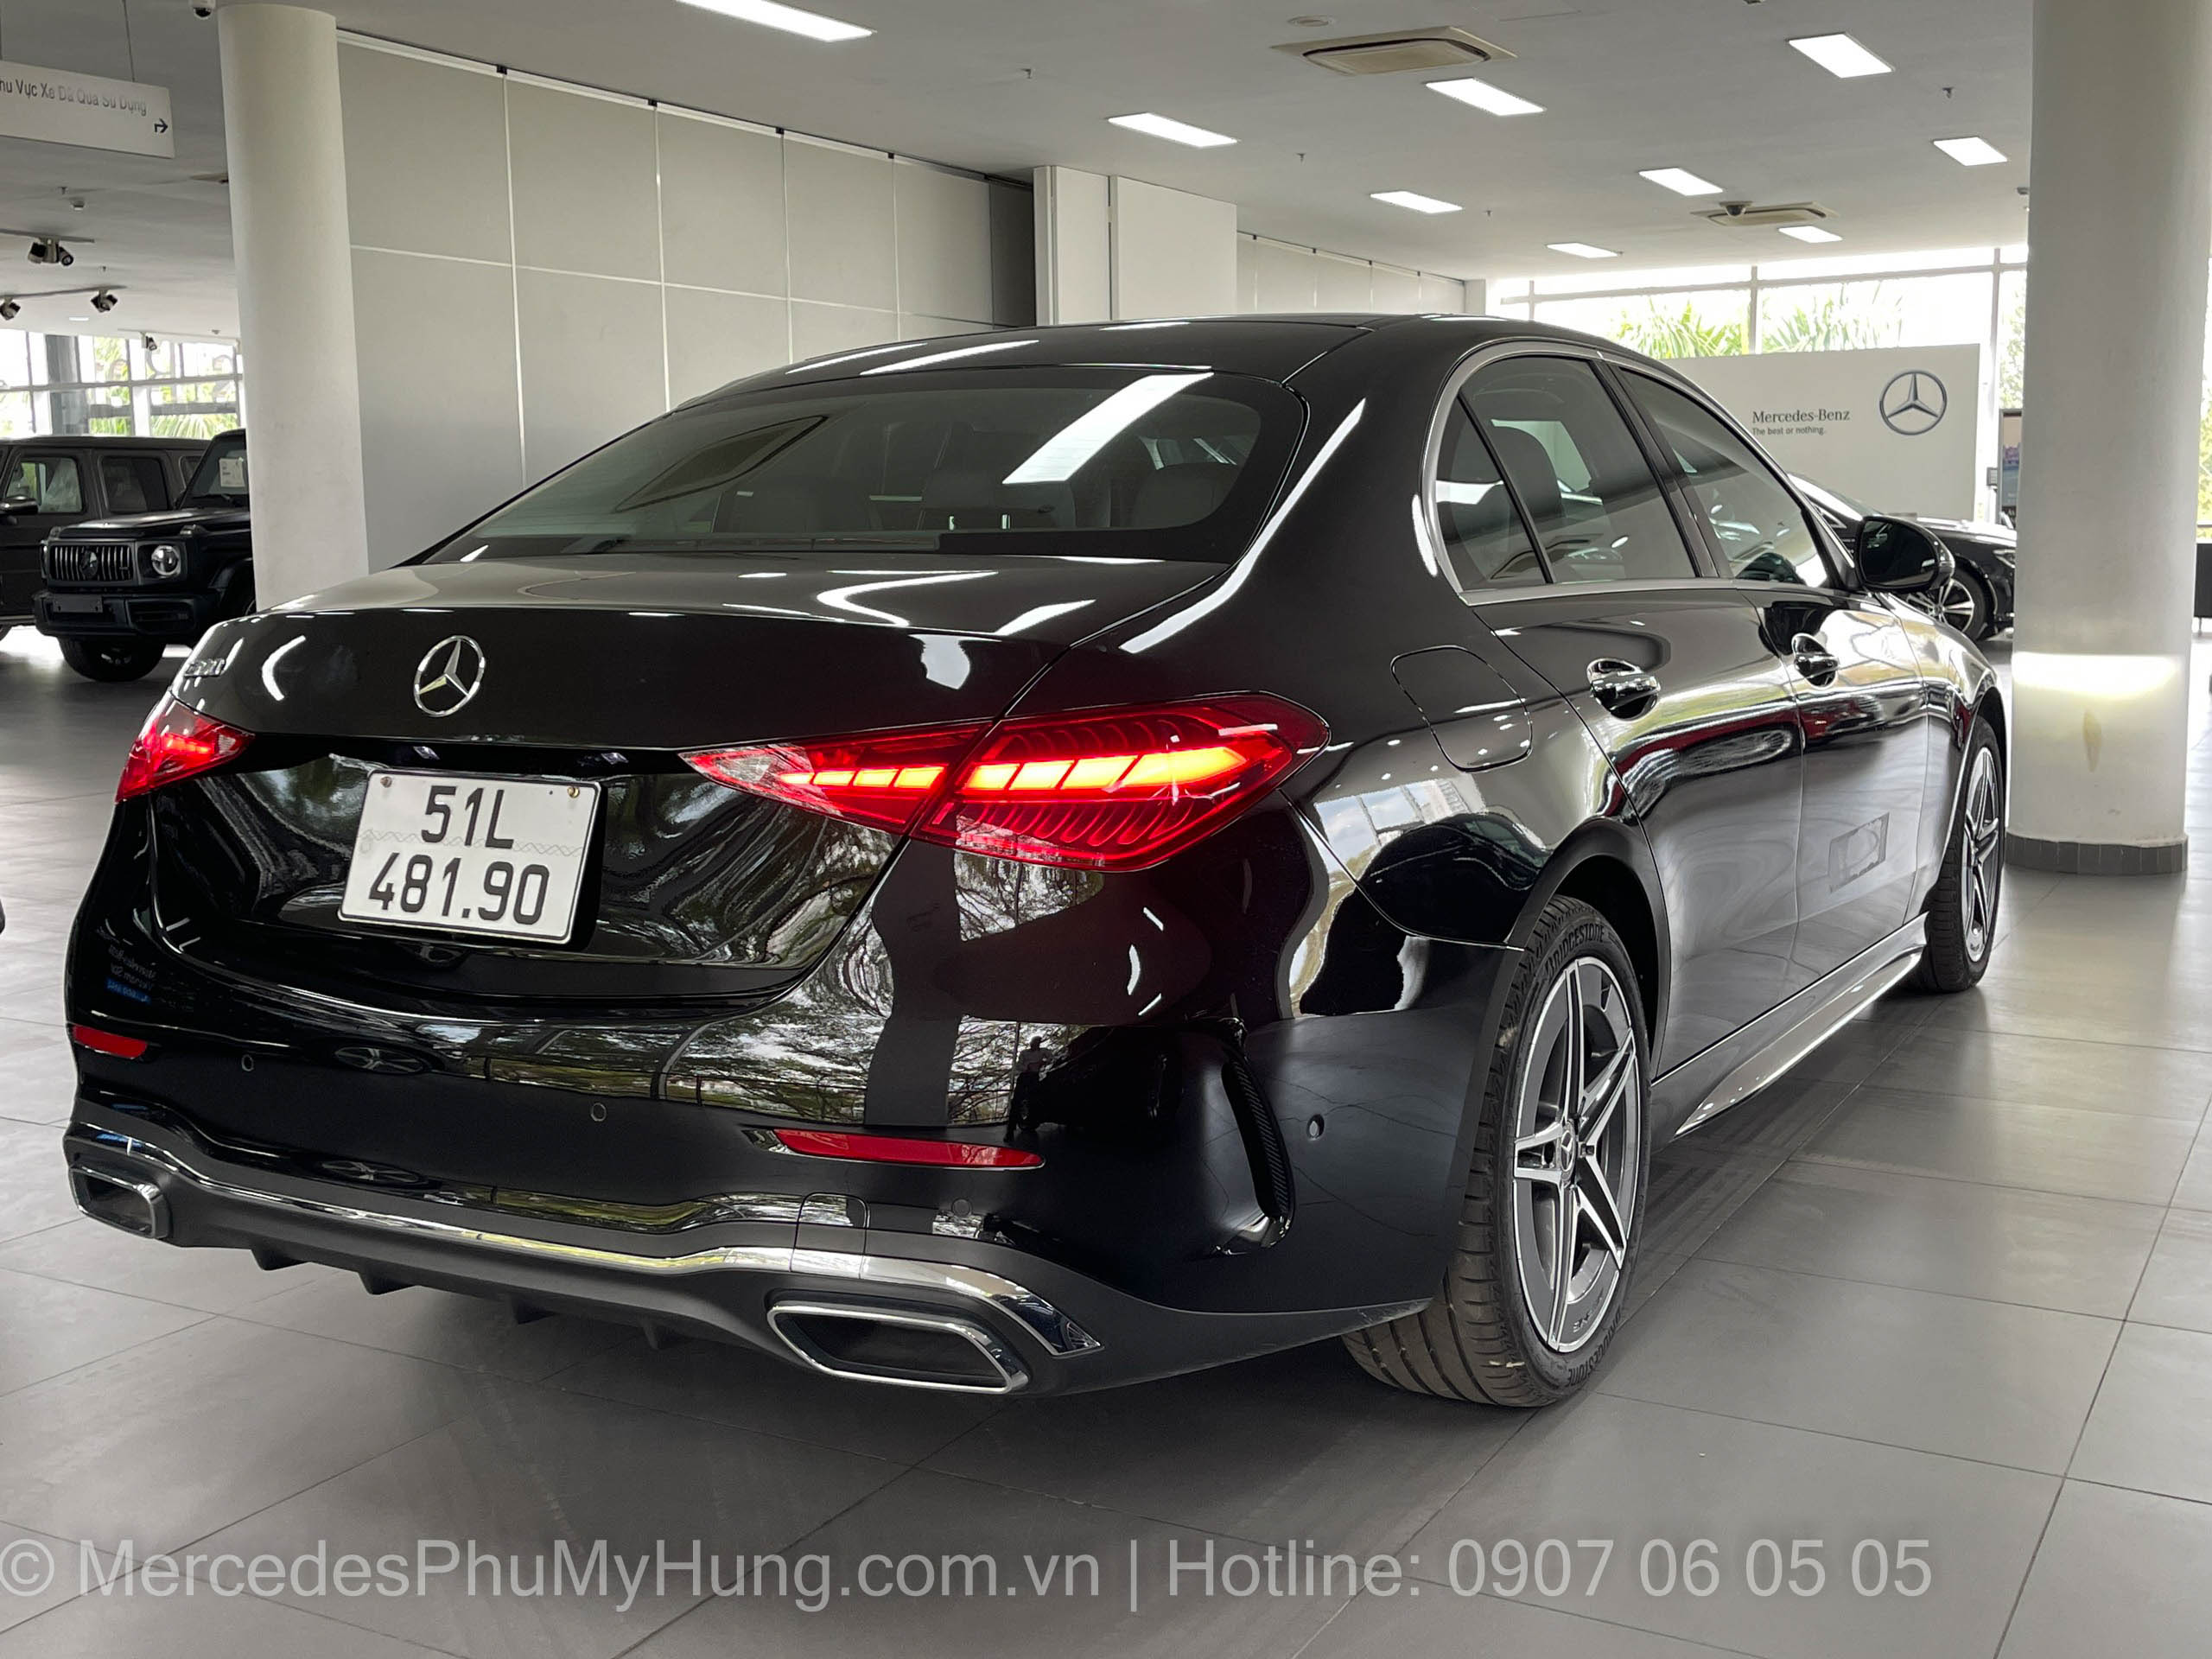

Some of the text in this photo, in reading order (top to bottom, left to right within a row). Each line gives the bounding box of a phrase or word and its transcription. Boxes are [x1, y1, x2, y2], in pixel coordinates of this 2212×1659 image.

[1752, 408, 1851, 423] Mercedes-Benz
[1752, 428, 1765, 436] The
[421, 785, 515, 849] 51L
[368, 852, 550, 925] 481.90
